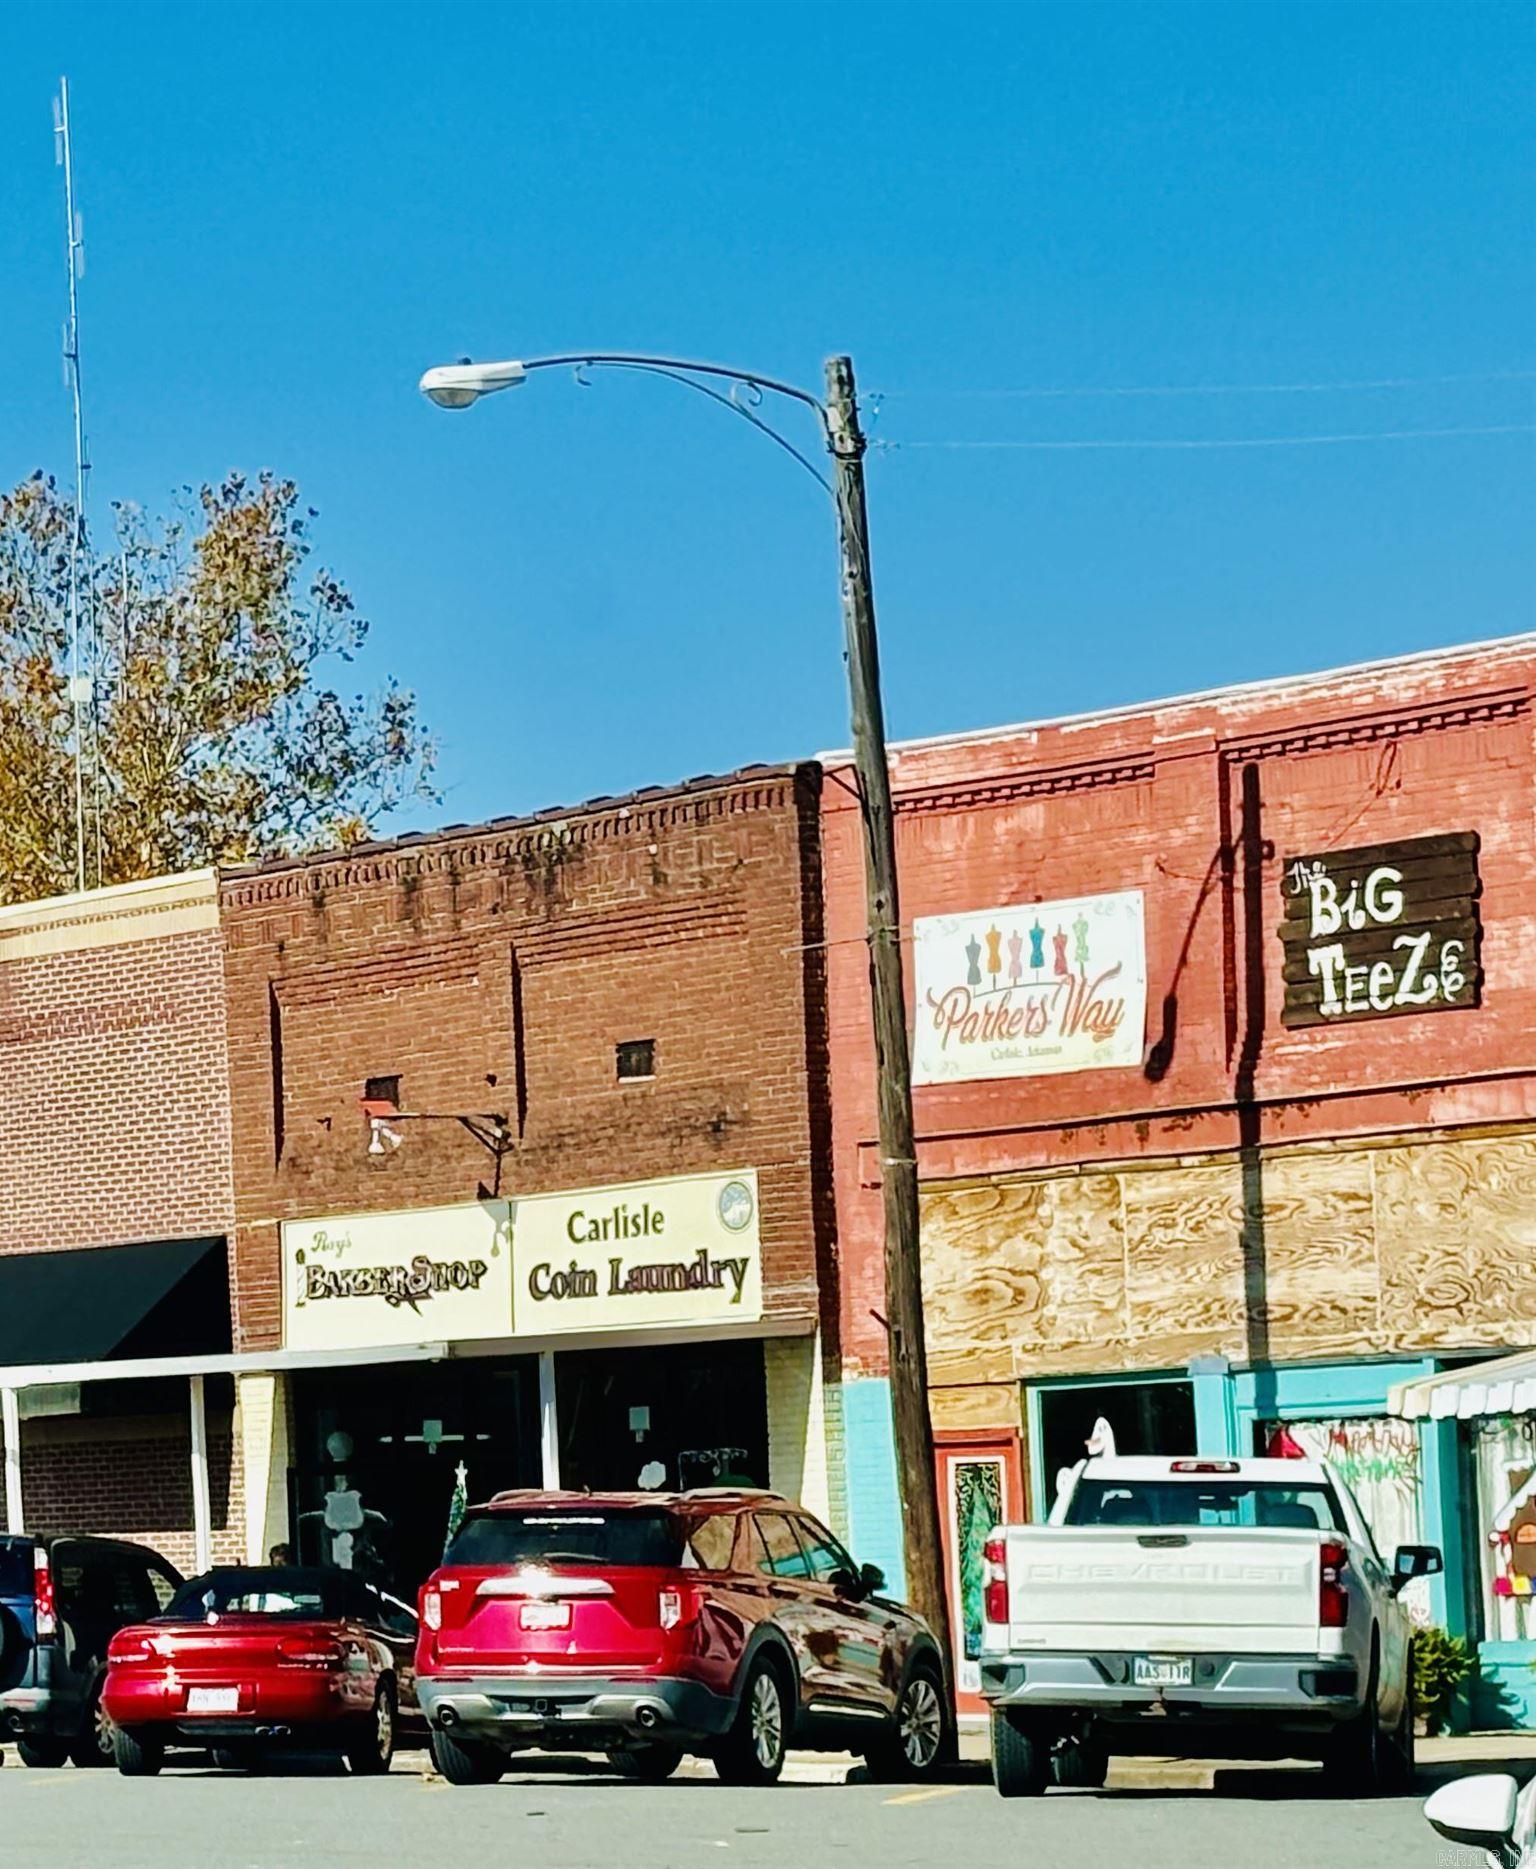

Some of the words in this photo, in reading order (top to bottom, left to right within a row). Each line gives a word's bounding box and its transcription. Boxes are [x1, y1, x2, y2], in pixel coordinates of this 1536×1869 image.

[567, 1203, 665, 1244] Carlisle
[528, 1259, 598, 1302] Coin
[607, 1248, 751, 1304] Laundry
[1027, 1562, 1298, 1583] CHEVROLET
